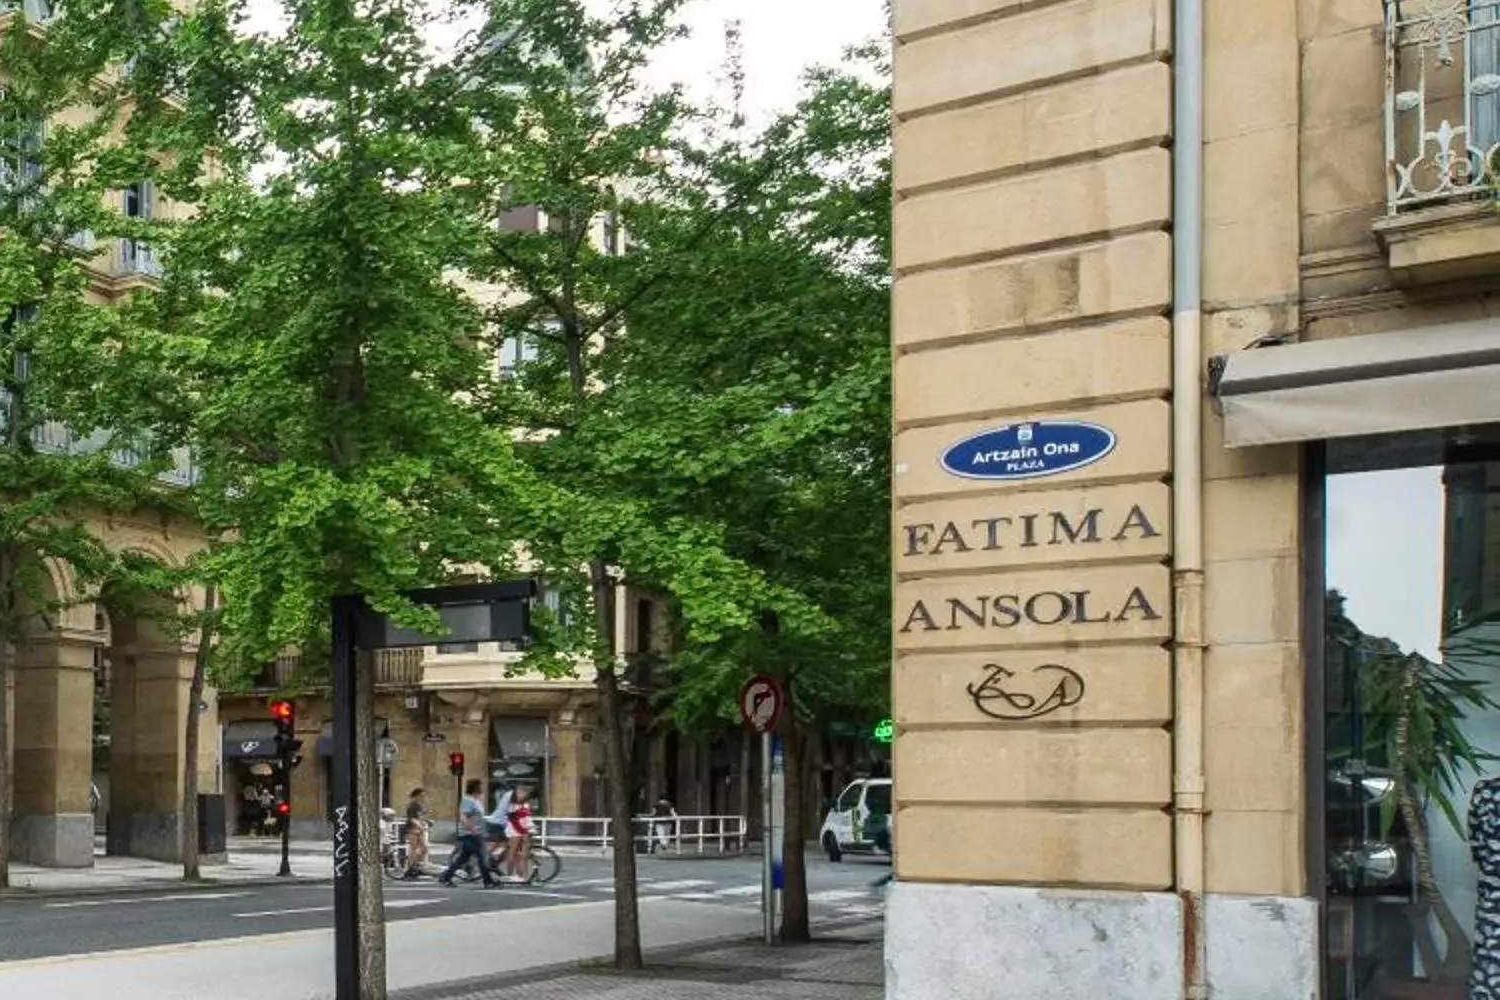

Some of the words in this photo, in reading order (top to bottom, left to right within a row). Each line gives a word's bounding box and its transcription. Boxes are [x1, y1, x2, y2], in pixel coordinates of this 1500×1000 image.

[972, 445, 1038, 465] Artzain
[1043, 442, 1080, 456] Ona
[1007, 459, 1045, 472] PLAZA
[902, 503, 1162, 557] FATIMA
[899, 586, 1163, 633] ANSOLA
